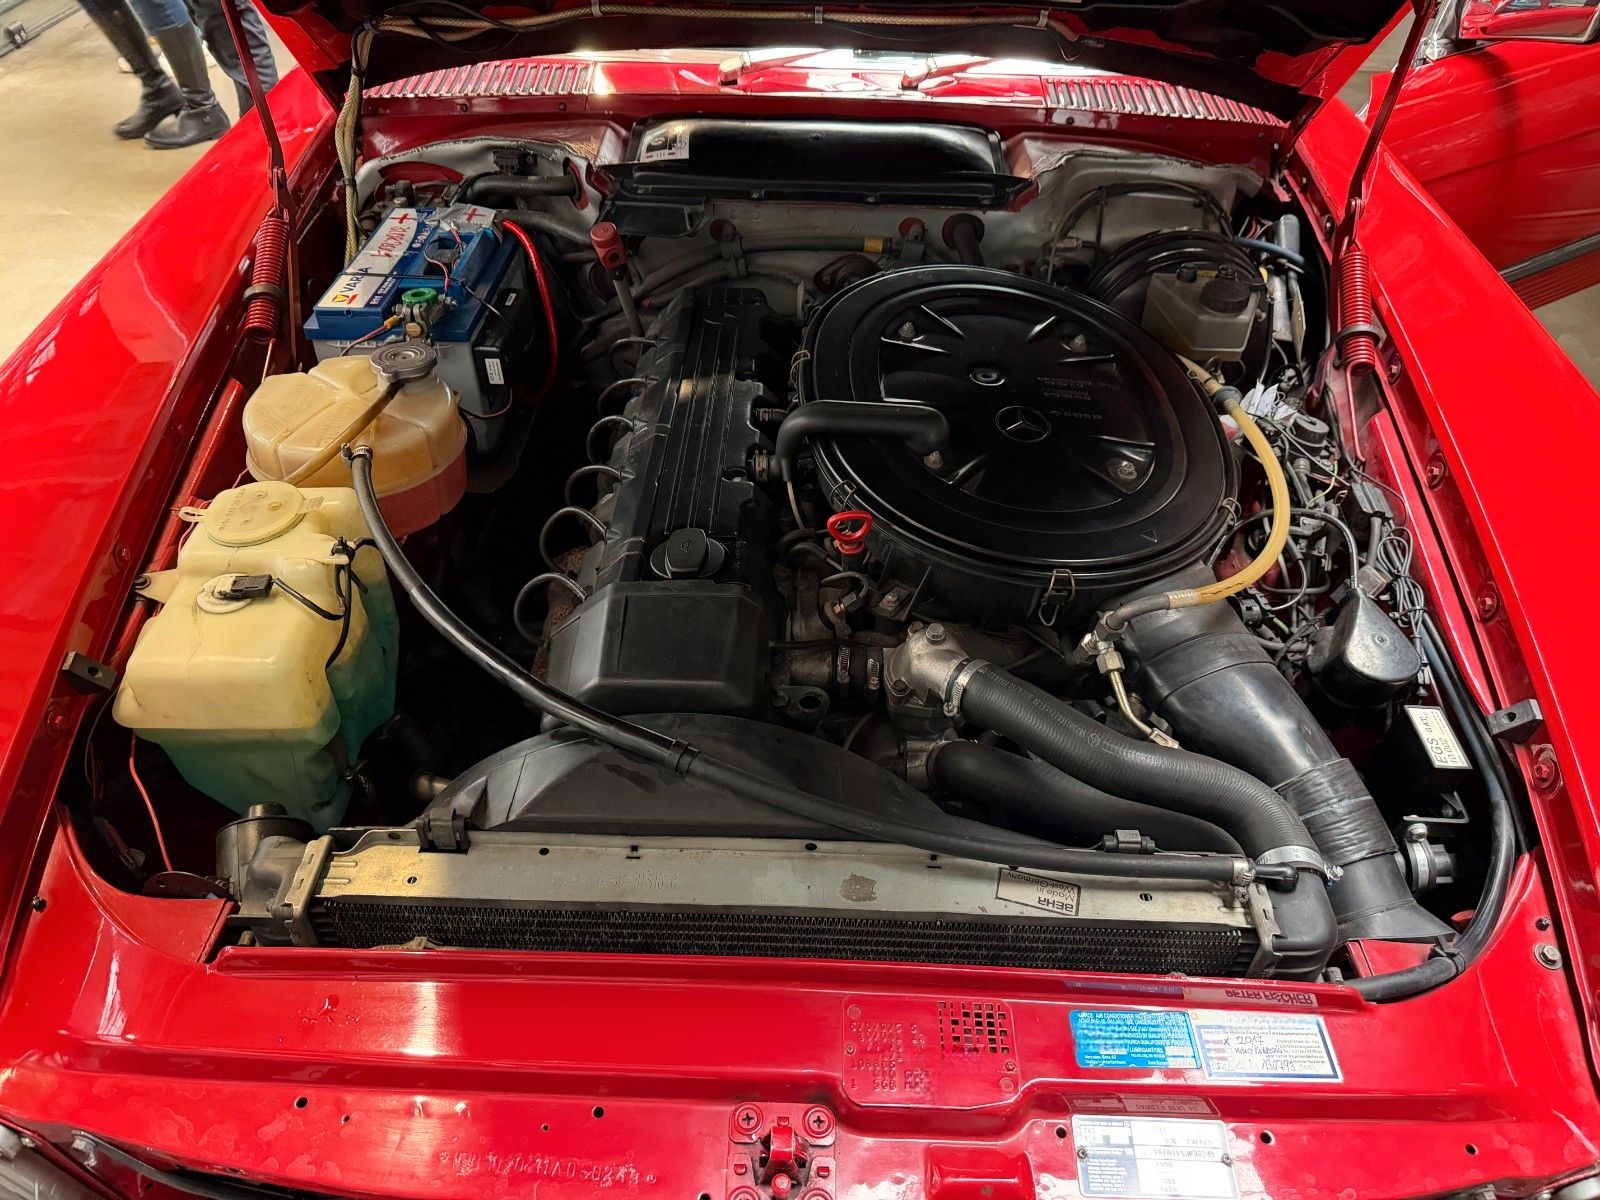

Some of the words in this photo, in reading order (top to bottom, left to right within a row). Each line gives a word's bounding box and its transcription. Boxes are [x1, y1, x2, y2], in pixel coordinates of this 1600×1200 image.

[1427, 737, 1448, 764] EGS
[1006, 872, 1075, 894] West-Germany
[1037, 896, 1074, 912] BEHR
[1047, 889, 1074, 902] Made
